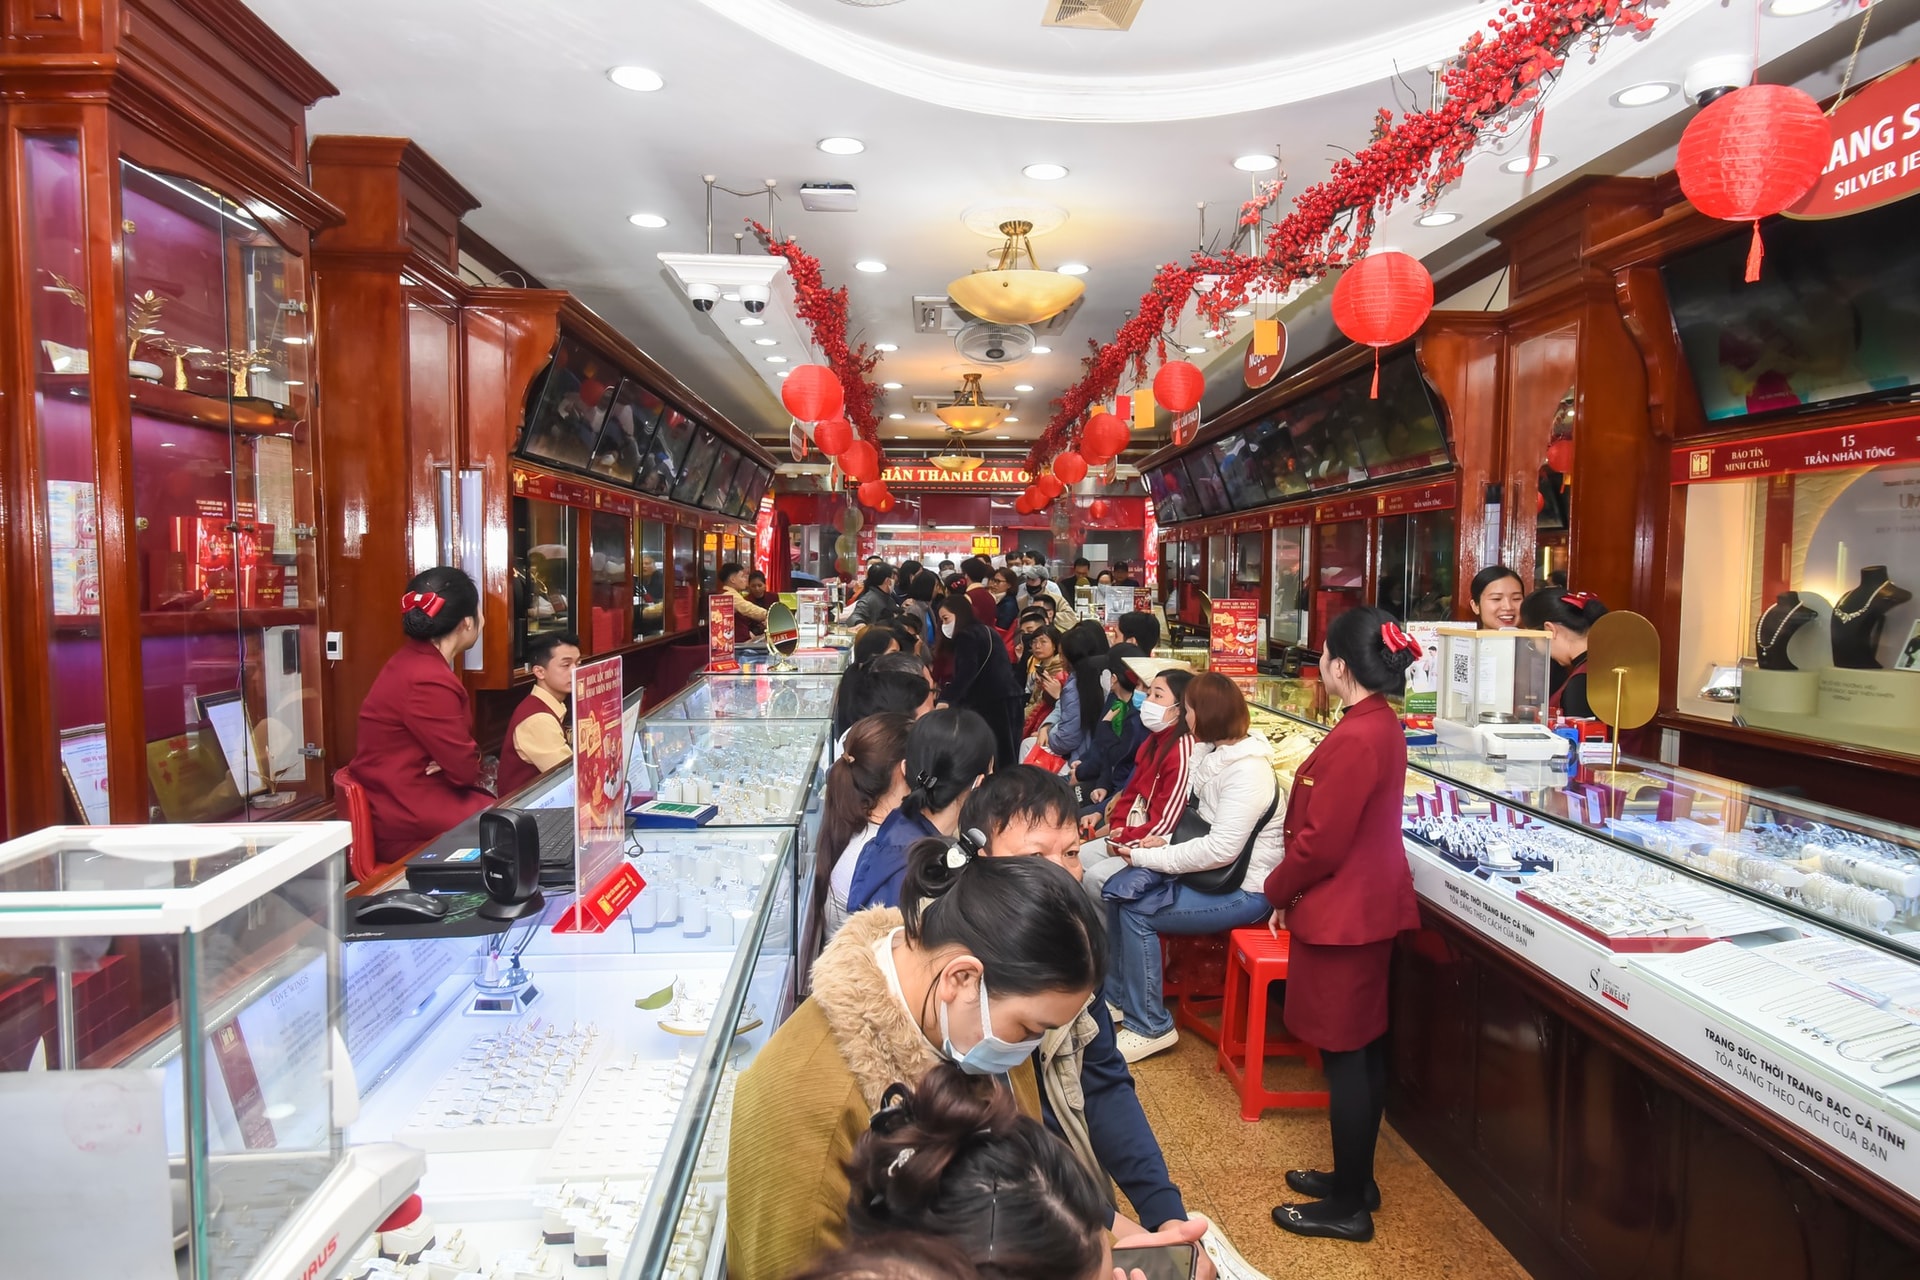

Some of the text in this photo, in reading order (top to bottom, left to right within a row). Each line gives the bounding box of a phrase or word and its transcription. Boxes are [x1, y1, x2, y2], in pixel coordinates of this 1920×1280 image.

[1821, 115, 1894, 176] ANG
[1834, 161, 1897, 200] SILVER
[1731, 447, 1763, 460] BẢO TÍN
[1841, 435, 1855, 447] 15
[1725, 459, 1771, 472] MINH CHÂU
[1804, 446, 1896, 466] TRẦN NHÂN TÔNG
[881, 466, 914, 481] HÂN
[977, 467, 1013, 483] CẢM
[1444, 880, 1459, 895] TRANG
[1459, 888, 1470, 901] SỨC
[1470, 894, 1482, 908] THỜI
[1482, 901, 1500, 918] TRANG
[1500, 911, 1511, 925] BẠC
[1522, 924, 1535, 938] TÍNH
[1472, 908, 1487, 923] THEO
[1487, 915, 1502, 932] CÁCH
[1503, 924, 1514, 939] CỦA
[271, 989, 289, 1008] LOVE
[1602, 983, 1630, 1004] JEWELRY
[1705, 1027, 1906, 1150] TRANG SỨC THỜI TRANG BẠC CÁ TÍNH
[1736, 1061, 1764, 1088] SÁNG
[1766, 1080, 1795, 1106] THEO
[1798, 1098, 1830, 1127] CÁCH
[1833, 1119, 1858, 1144] CỦA
[1861, 1136, 1889, 1162] BẠN
[299, 1236, 337, 1280] AUS
